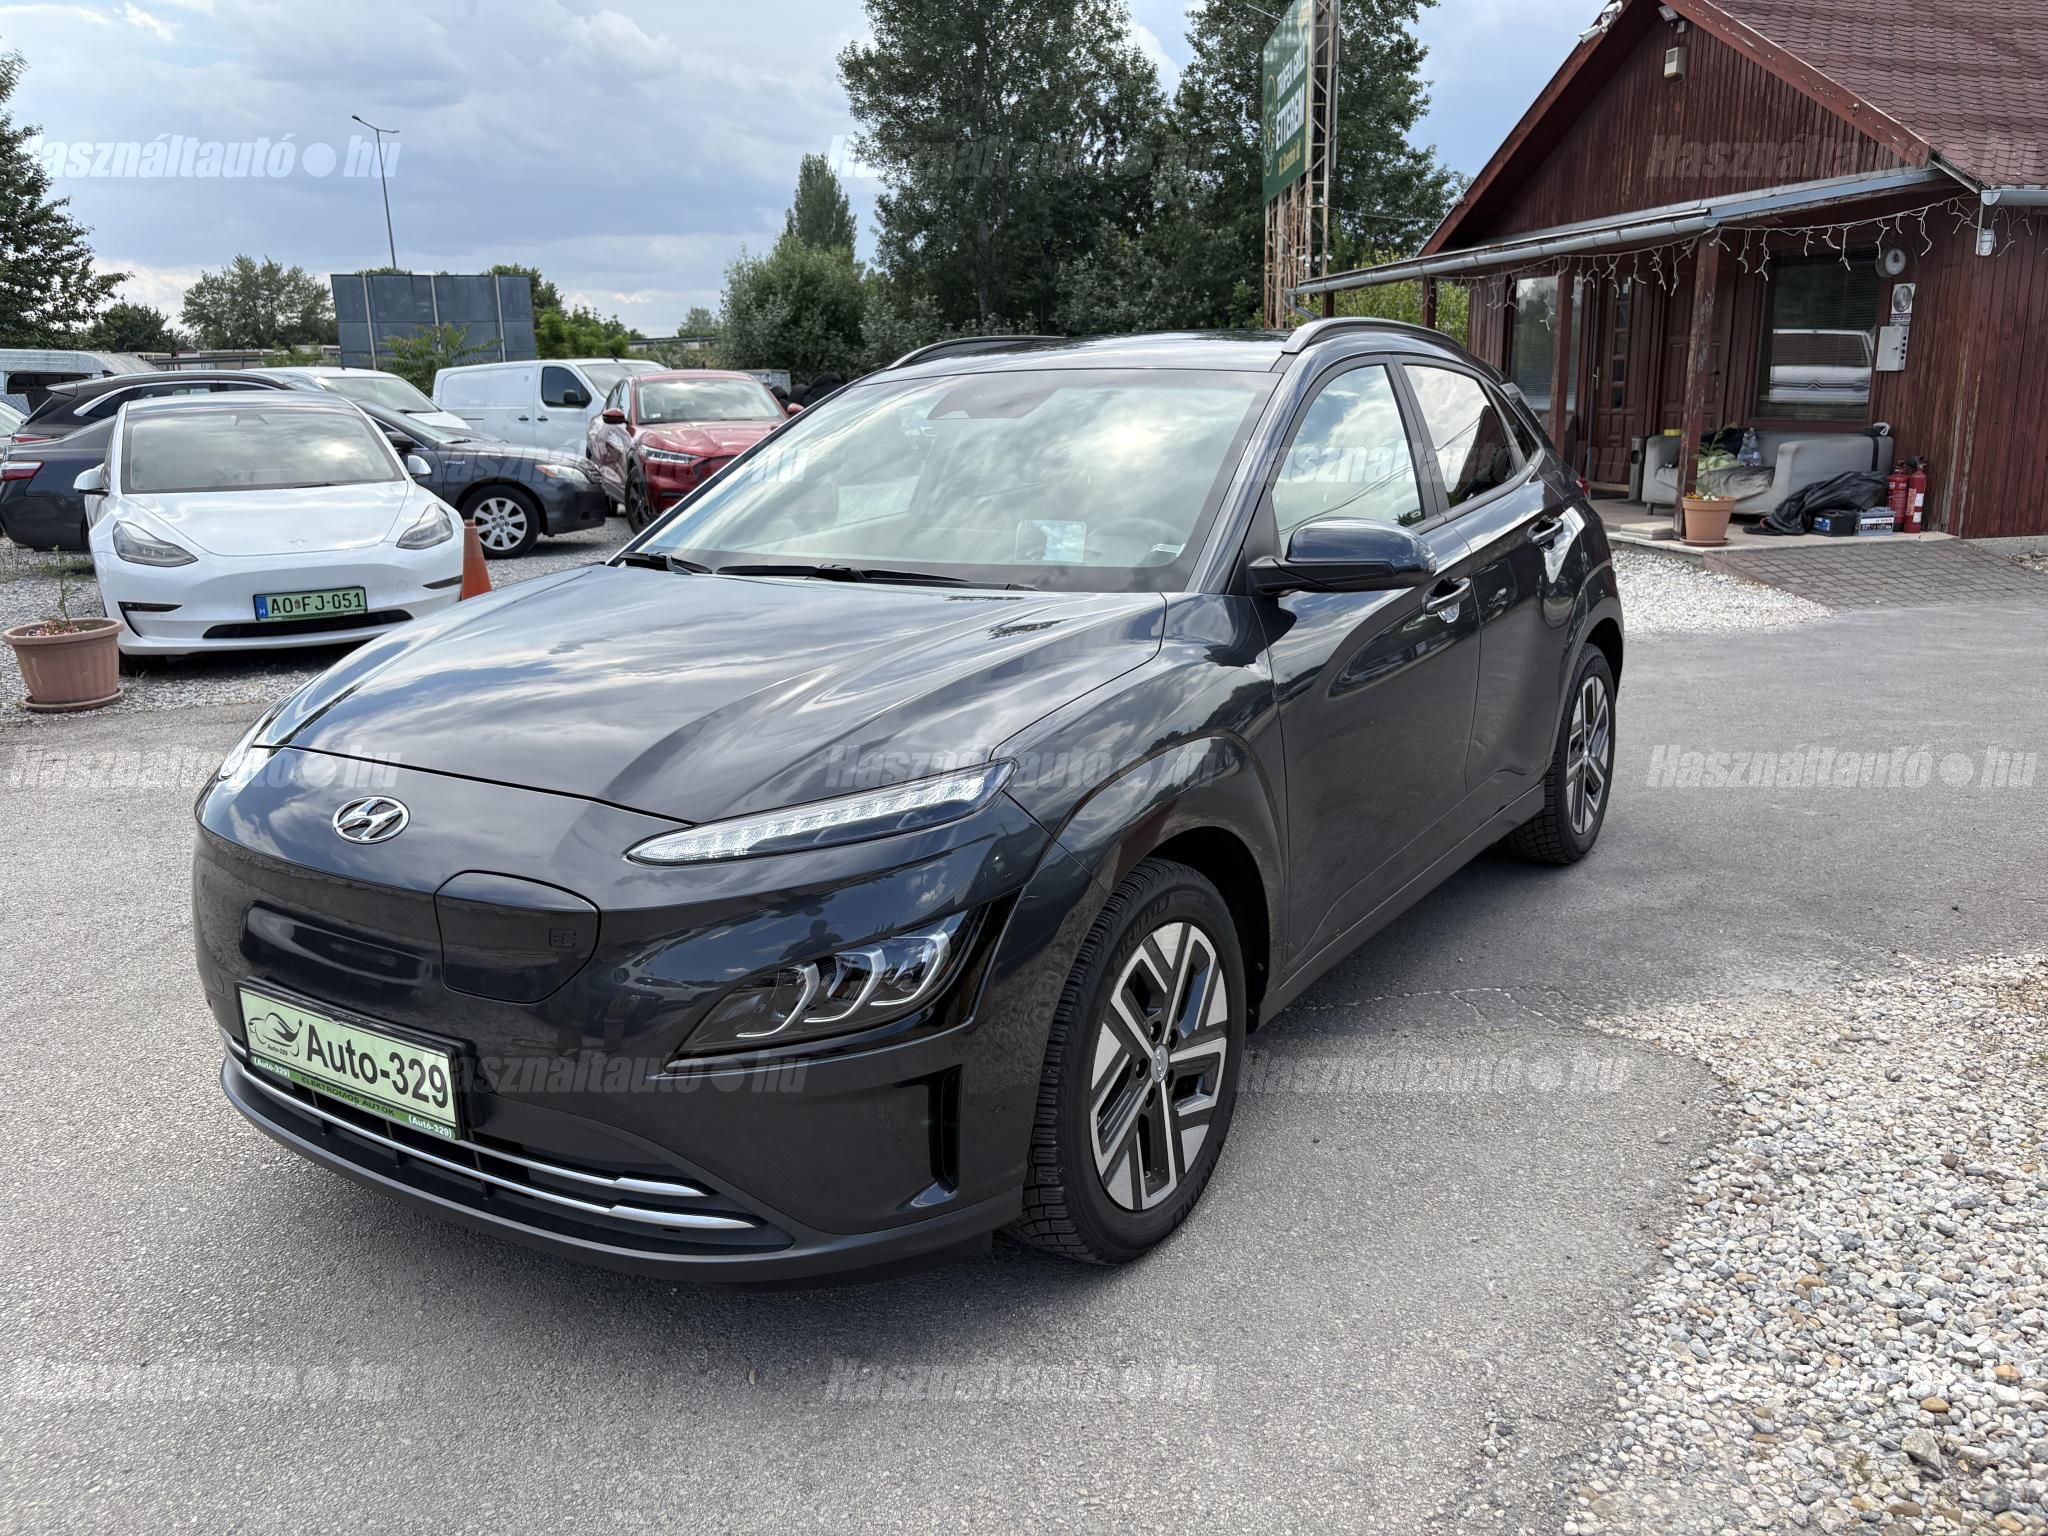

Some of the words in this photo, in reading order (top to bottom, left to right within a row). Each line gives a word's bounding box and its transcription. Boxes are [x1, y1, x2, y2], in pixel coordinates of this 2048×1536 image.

[302, 592, 363, 612] FJ-051
[306, 1023, 449, 1109] Auto-329
[301, 1076, 360, 1105] ELEKTROMOS
